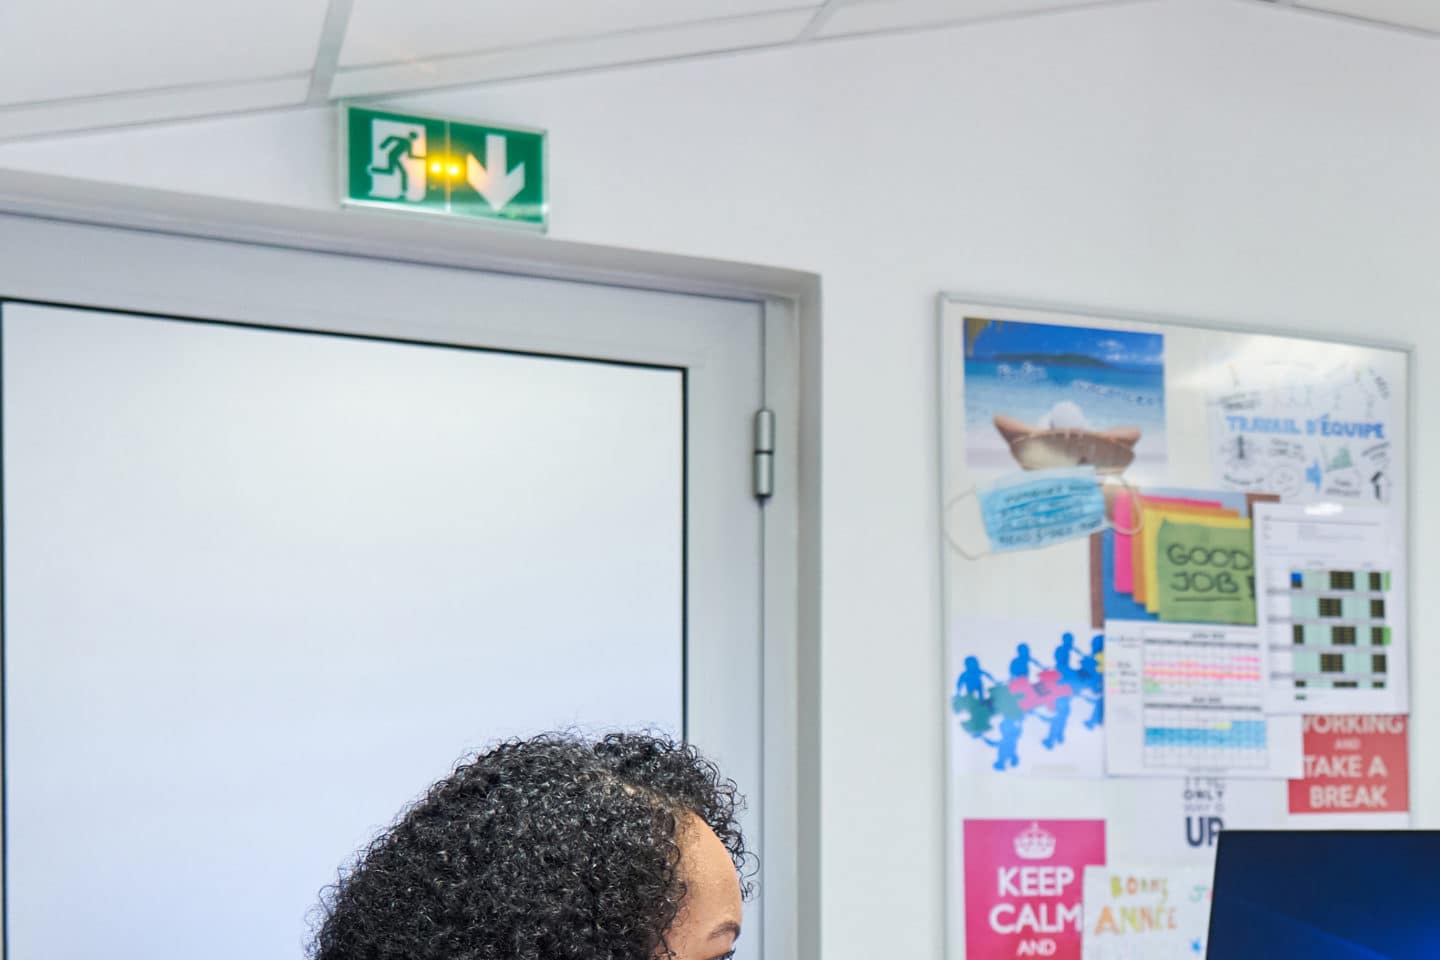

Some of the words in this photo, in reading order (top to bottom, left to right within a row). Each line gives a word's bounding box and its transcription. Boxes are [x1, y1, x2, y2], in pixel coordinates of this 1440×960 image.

[1226, 416, 1301, 434] TRAVAIL
[1167, 543, 1254, 571] GOOD
[1170, 571, 1240, 593] JOB
[1304, 755, 1363, 778] TAKE
[1368, 755, 1388, 778] A
[1310, 785, 1388, 808] BREAK
[997, 866, 1075, 897] KEEP
[989, 903, 1082, 934] CALM
[1017, 938, 1056, 956] AND
